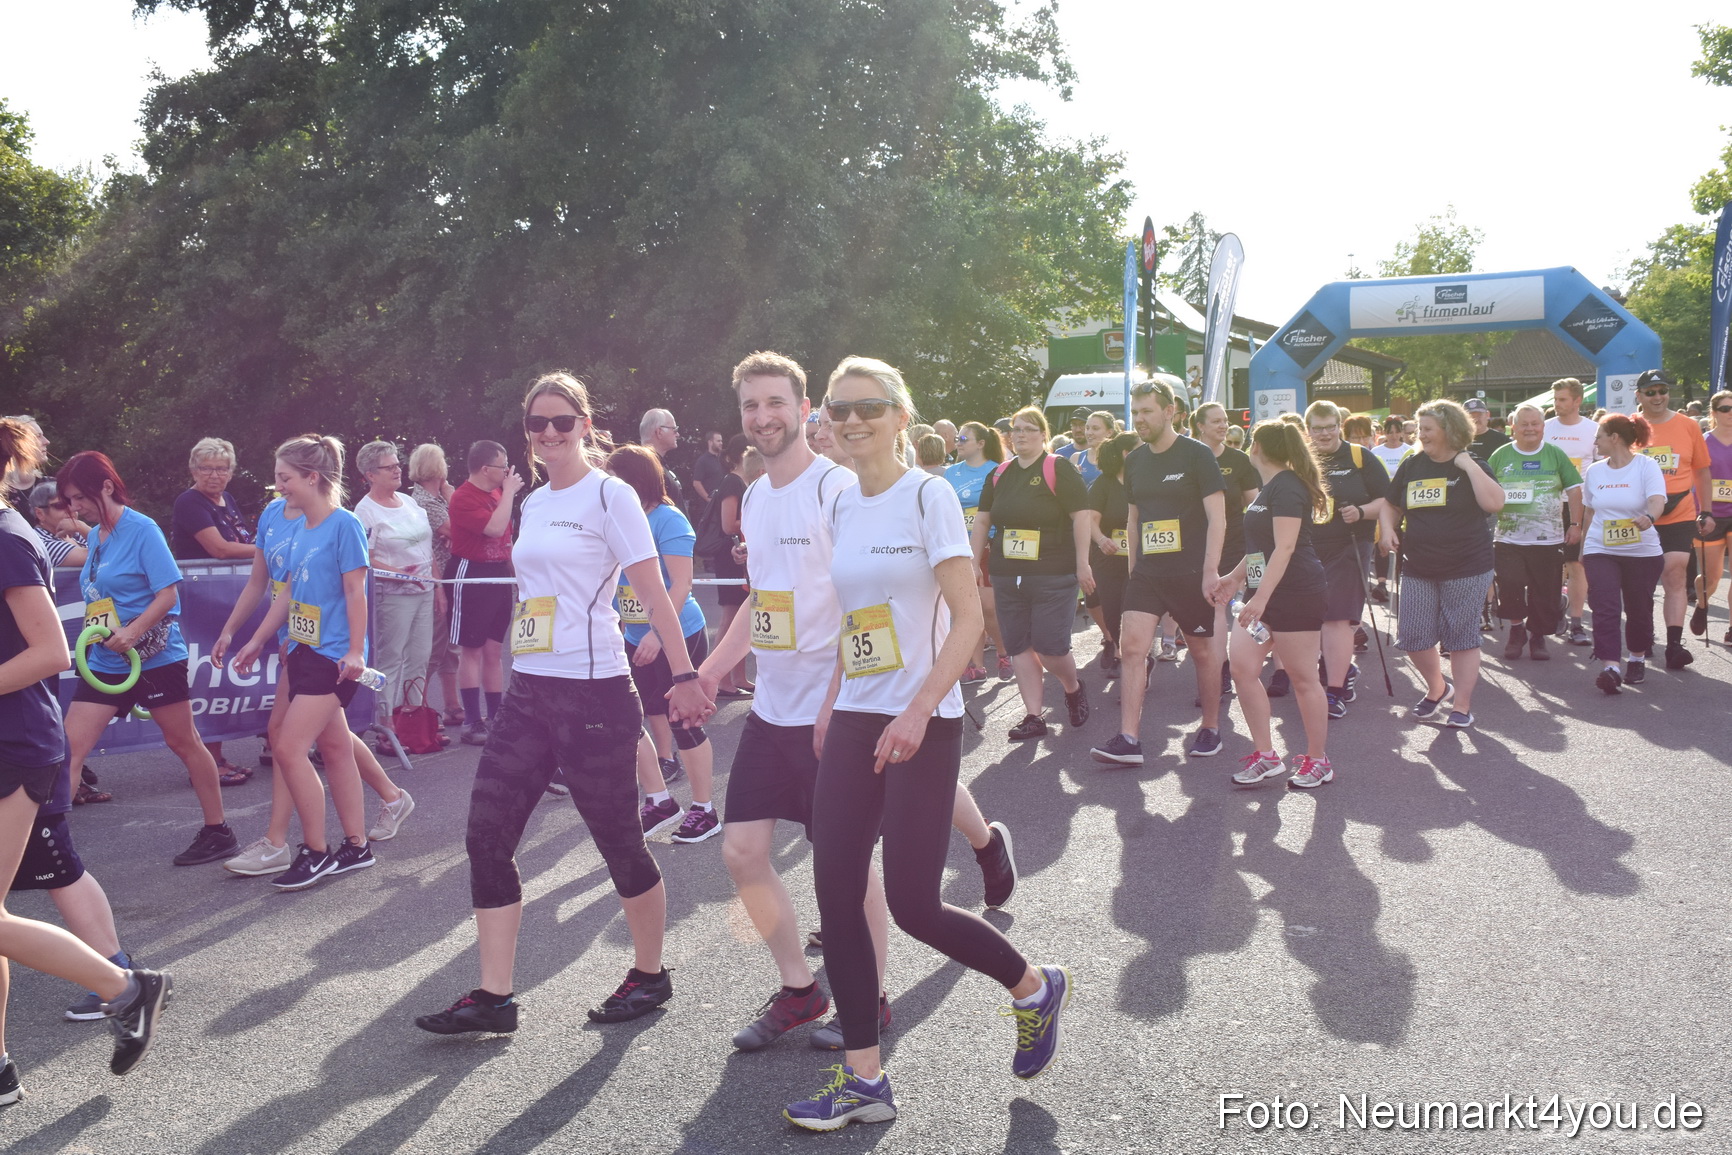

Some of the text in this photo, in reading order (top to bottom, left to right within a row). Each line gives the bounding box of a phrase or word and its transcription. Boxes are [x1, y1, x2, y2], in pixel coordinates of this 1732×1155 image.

[1423, 301, 1496, 318] firmenlauf
[1289, 329, 1328, 343] Fischer
[1411, 487, 1441, 500] 1458
[1507, 491, 1527, 500] 9069
[1718, 487, 1732, 496] 62
[549, 520, 584, 531] auctores
[1145, 531, 1175, 545] 1453
[1607, 527, 1635, 539] 1181
[779, 536, 811, 546] auctores
[1012, 539, 1025, 551] 71
[870, 544, 913, 555] auctores
[619, 598, 644, 613] 1525
[291, 614, 315, 635] 1533
[518, 617, 536, 639] 30
[754, 610, 772, 633] 33
[851, 631, 873, 659] 35
[862, 655, 881, 664] Martina
[191, 694, 276, 716] OBILE
